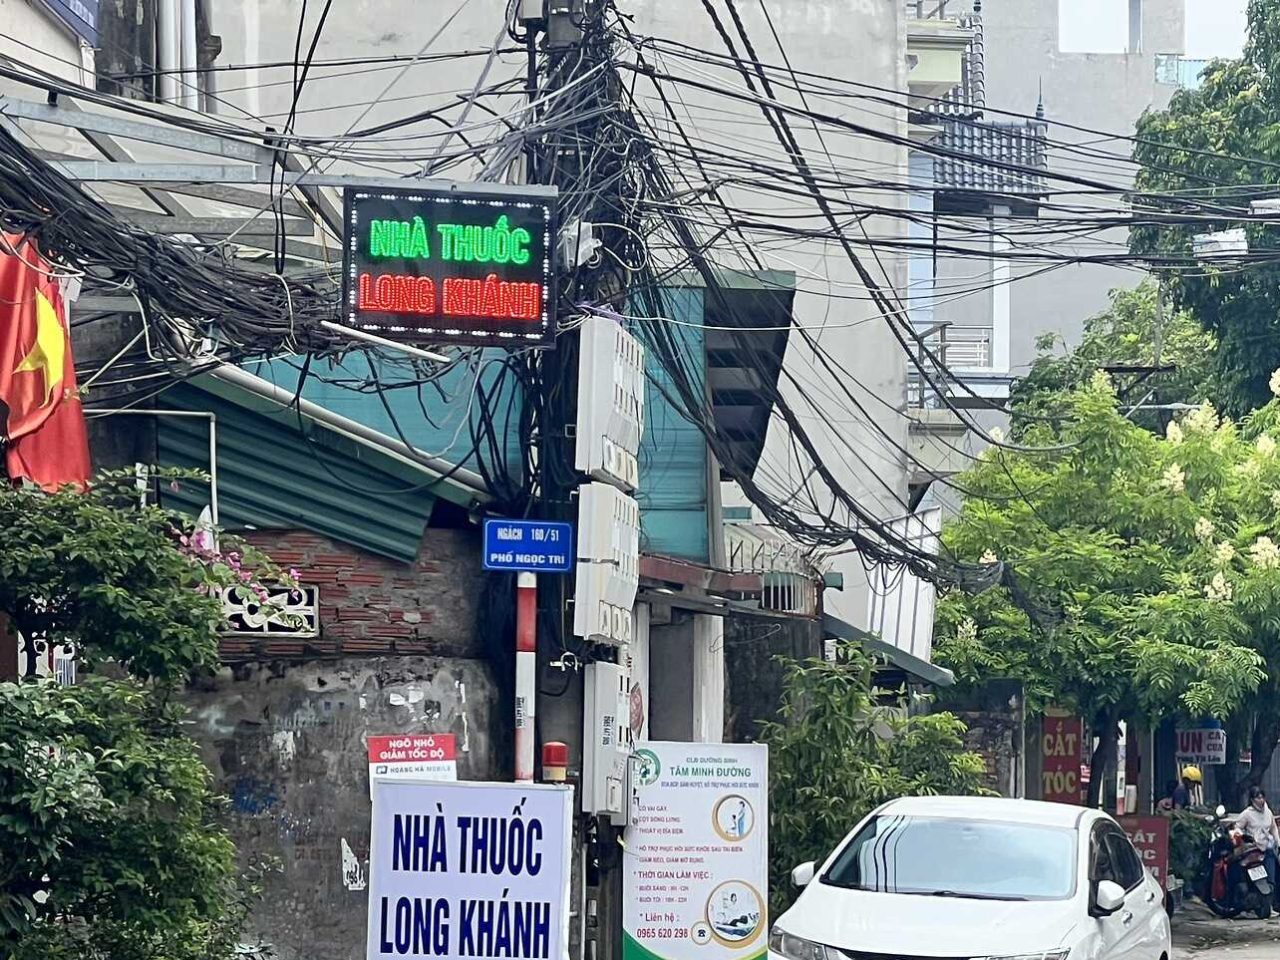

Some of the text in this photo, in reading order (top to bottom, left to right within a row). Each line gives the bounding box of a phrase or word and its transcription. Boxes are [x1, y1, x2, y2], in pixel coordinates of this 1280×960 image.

[370, 214, 530, 265] NHÀ THUỐC
[359, 272, 541, 319] LONG KHÁNH
[497, 525, 522, 540] NGÁCH
[490, 550, 513, 563] PHỐ
[515, 553, 545, 566] NGỌC
[380, 746, 444, 761] GIẢM TỐC ĐỘ
[691, 767, 714, 777] MINH
[392, 796, 543, 876] NHÀ THUỐC
[638, 869, 709, 881] THỜI GIAN LÀM VIỆC
[380, 888, 551, 959] LONG KHÁNH
[645, 912, 675, 924] Liên hệ
[636, 928, 688, 938] 0965 620 298
